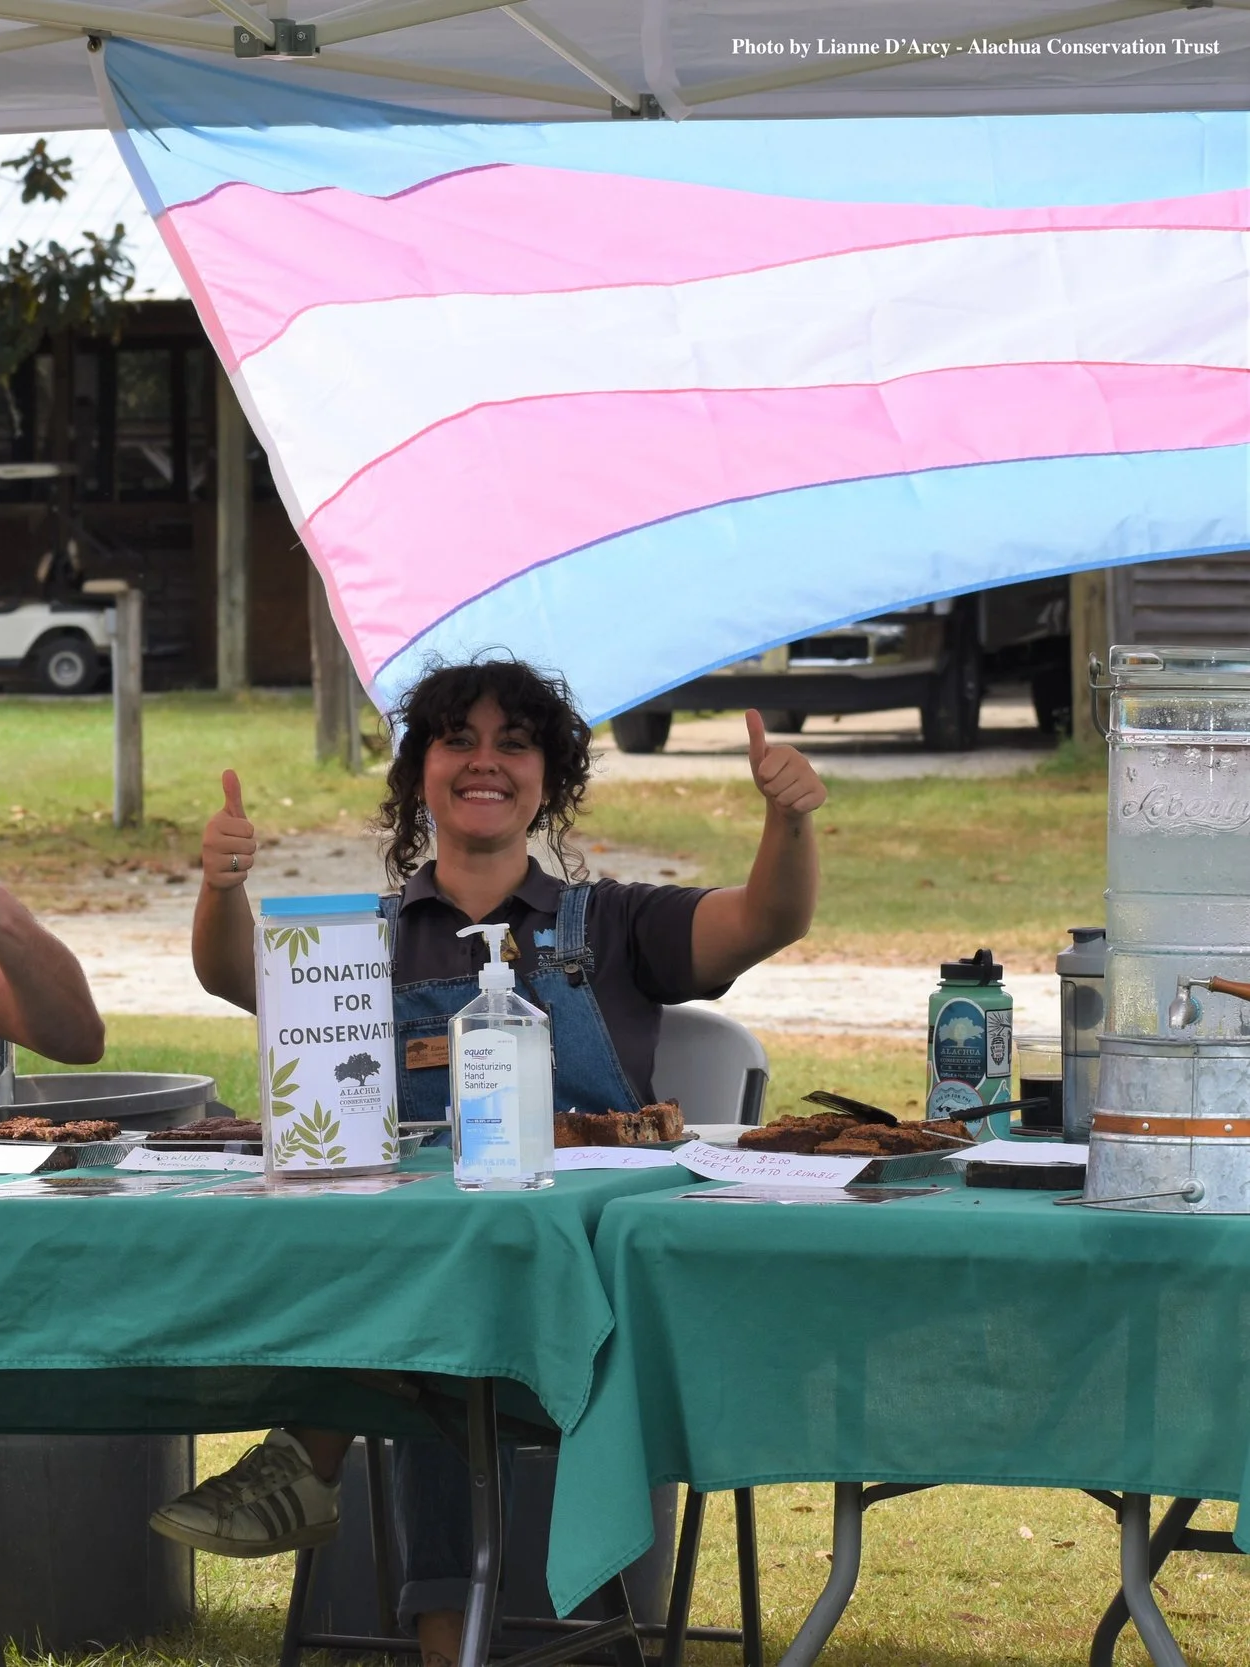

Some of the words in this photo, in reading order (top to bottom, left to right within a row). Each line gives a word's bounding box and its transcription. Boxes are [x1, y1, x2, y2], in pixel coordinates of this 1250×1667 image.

[334, 993, 372, 1012] FOR
[464, 1048, 493, 1058] equate
[940, 1048, 981, 1056] ALACHUA
[464, 1063, 512, 1072] Moisturizing
[464, 1072, 485, 1080] Hand
[464, 1081, 498, 1089] Sanitizer
[340, 1087, 381, 1097] ALACHUA
[142, 1153, 210, 1161] BROWNIES
[693, 1145, 745, 1164] VEGAN
[684, 1152, 732, 1171] SWEET
[735, 1165, 781, 1176] POTATO
[787, 1169, 842, 1180] CRUMBLE
